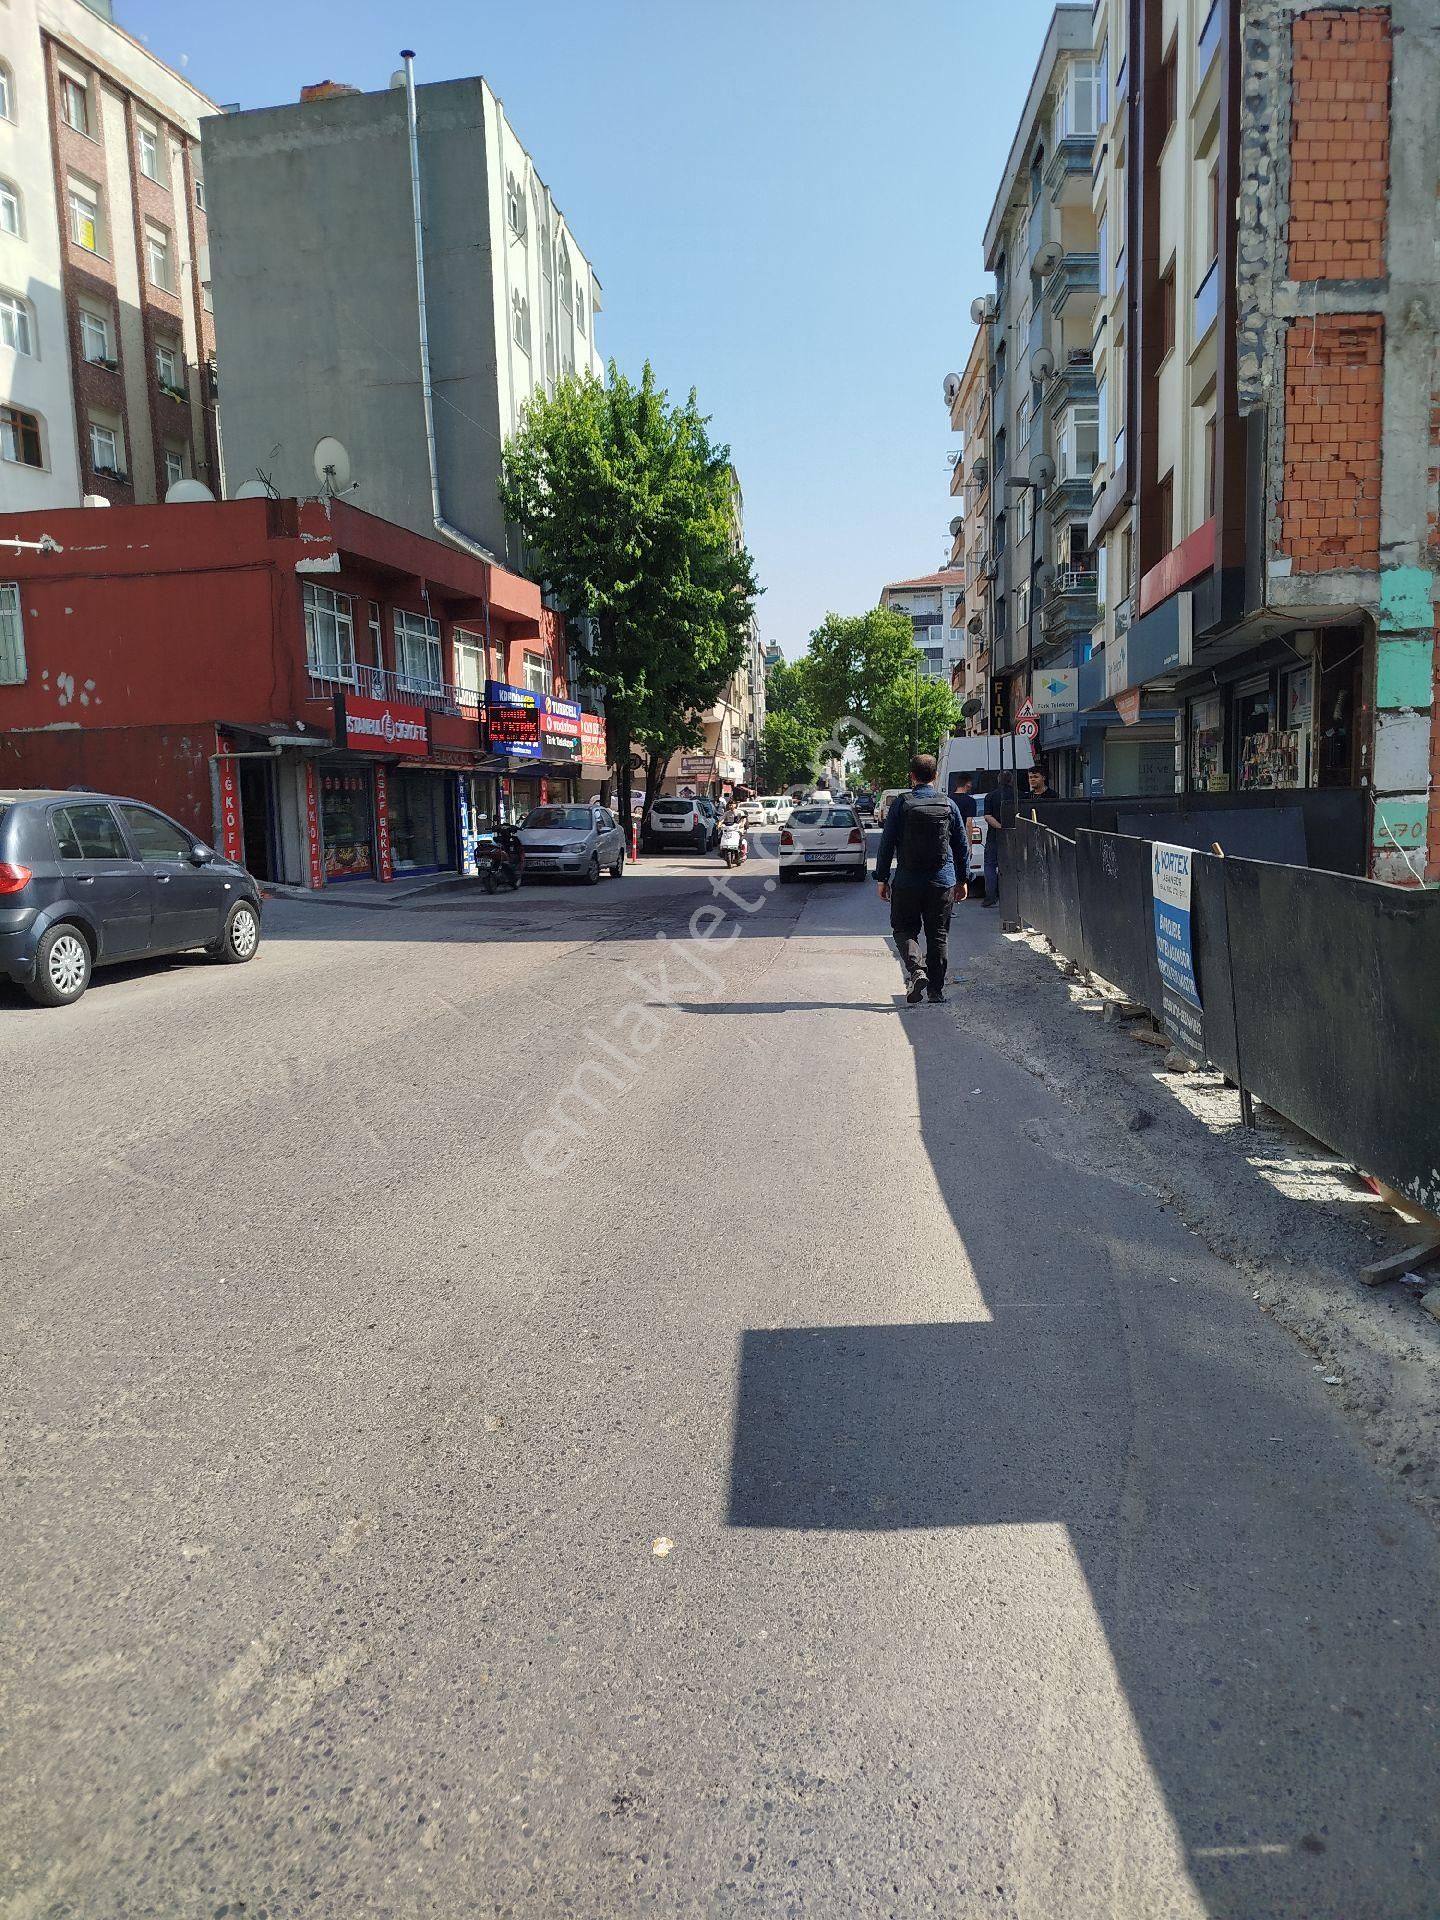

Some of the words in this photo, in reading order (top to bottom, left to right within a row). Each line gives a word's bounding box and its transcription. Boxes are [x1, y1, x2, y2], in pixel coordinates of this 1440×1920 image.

[553, 719, 578, 735] vodafone
[1020, 724, 1033, 735] 30
[377, 768, 387, 809] ASAF
[379, 818, 391, 880] BAKKAL
